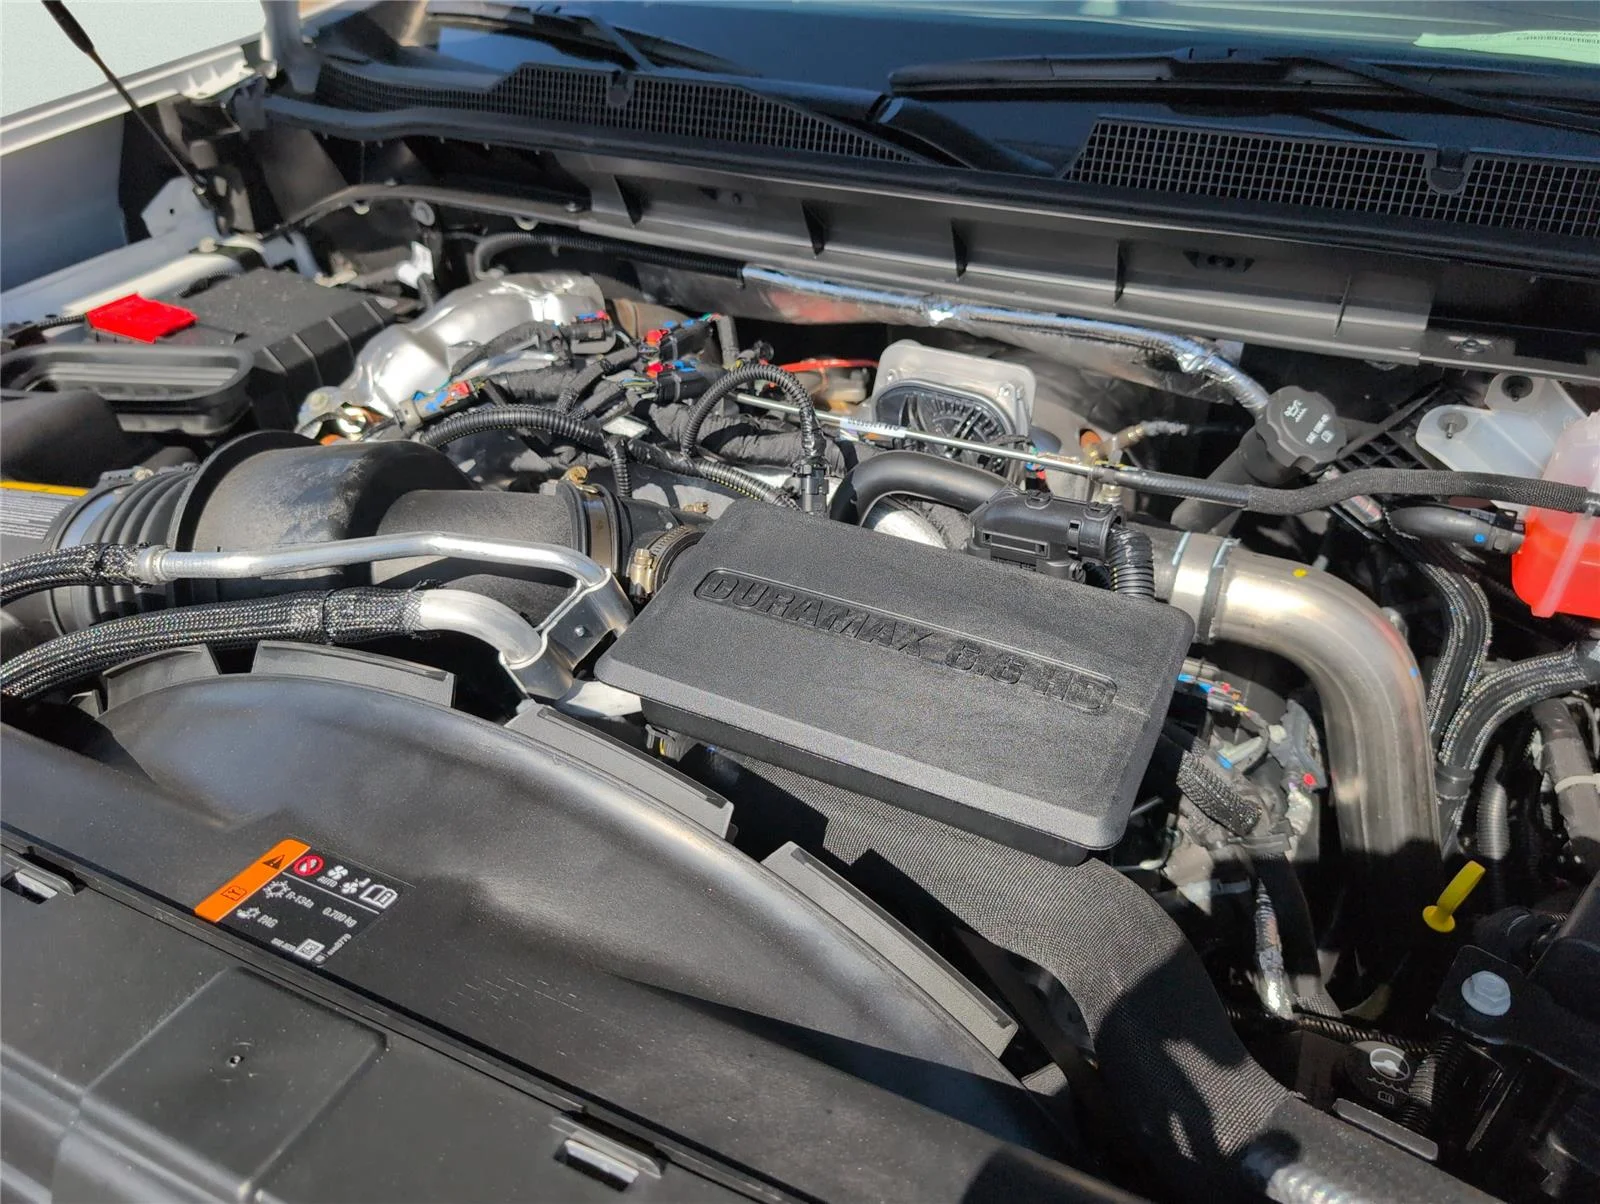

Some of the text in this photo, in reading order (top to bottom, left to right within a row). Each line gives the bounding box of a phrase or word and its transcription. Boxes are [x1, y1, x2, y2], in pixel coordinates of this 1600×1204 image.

[705, 578, 1108, 710] DURAMAX 6.6 HD
[317, 876, 337, 888] AUTO
[285, 892, 314, 908] R-134a
[322, 907, 346, 923] 0.700
[257, 915, 278, 928] PAG
